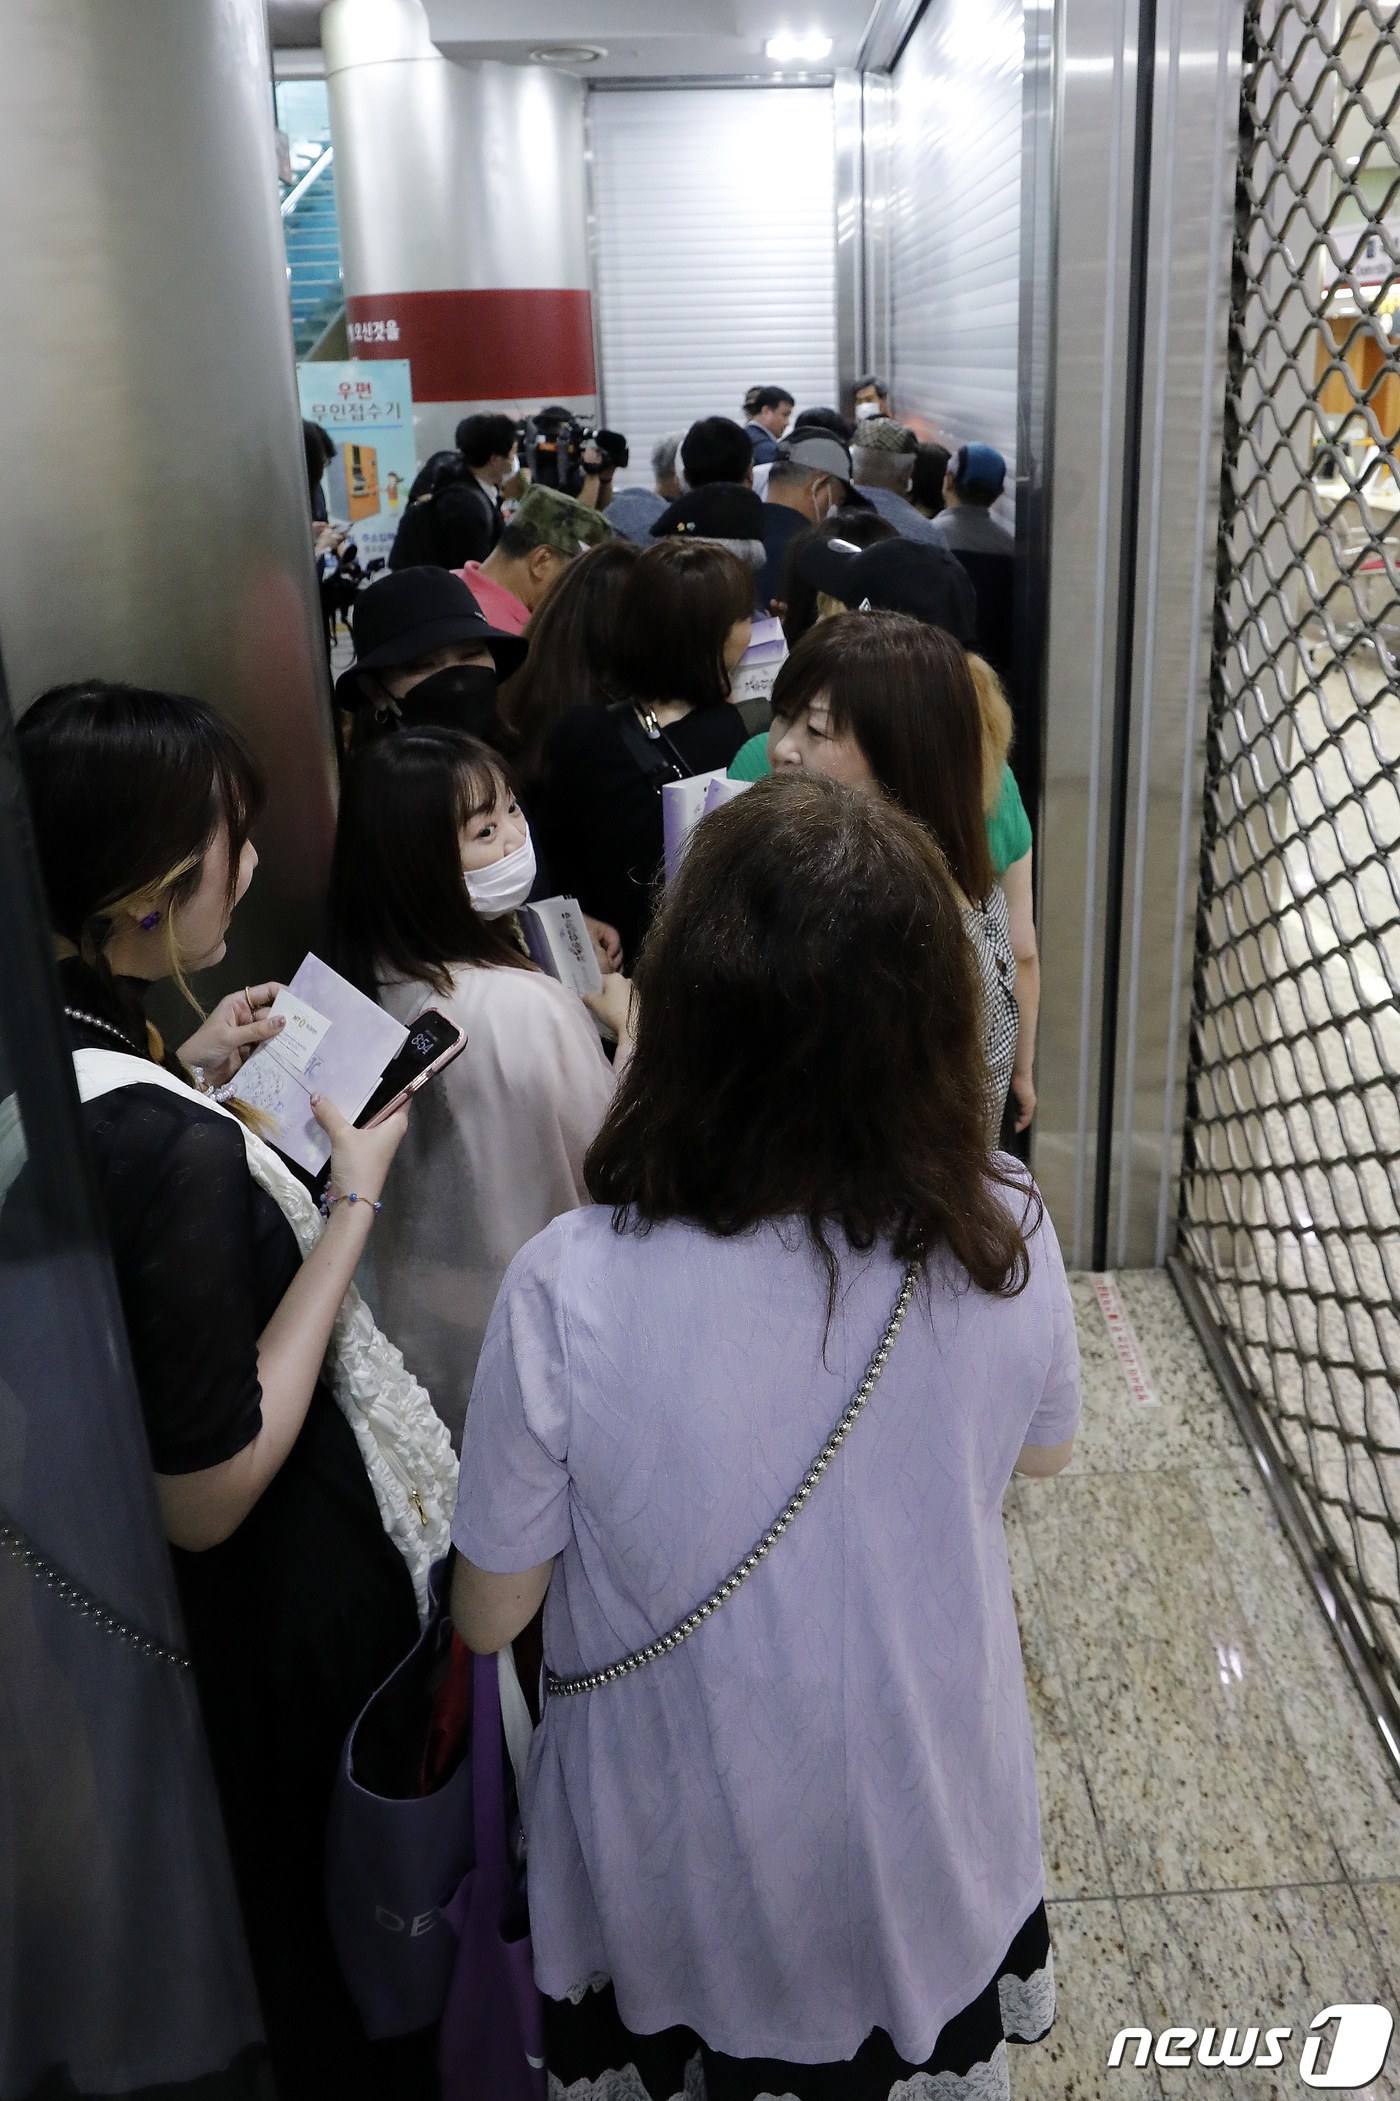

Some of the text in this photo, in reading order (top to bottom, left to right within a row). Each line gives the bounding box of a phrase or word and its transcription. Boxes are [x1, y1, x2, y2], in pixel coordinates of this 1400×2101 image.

[337, 381, 372, 401] 우편
[311, 401, 402, 423] 무인접수기
[411, 1033, 434, 1055] 8:54
